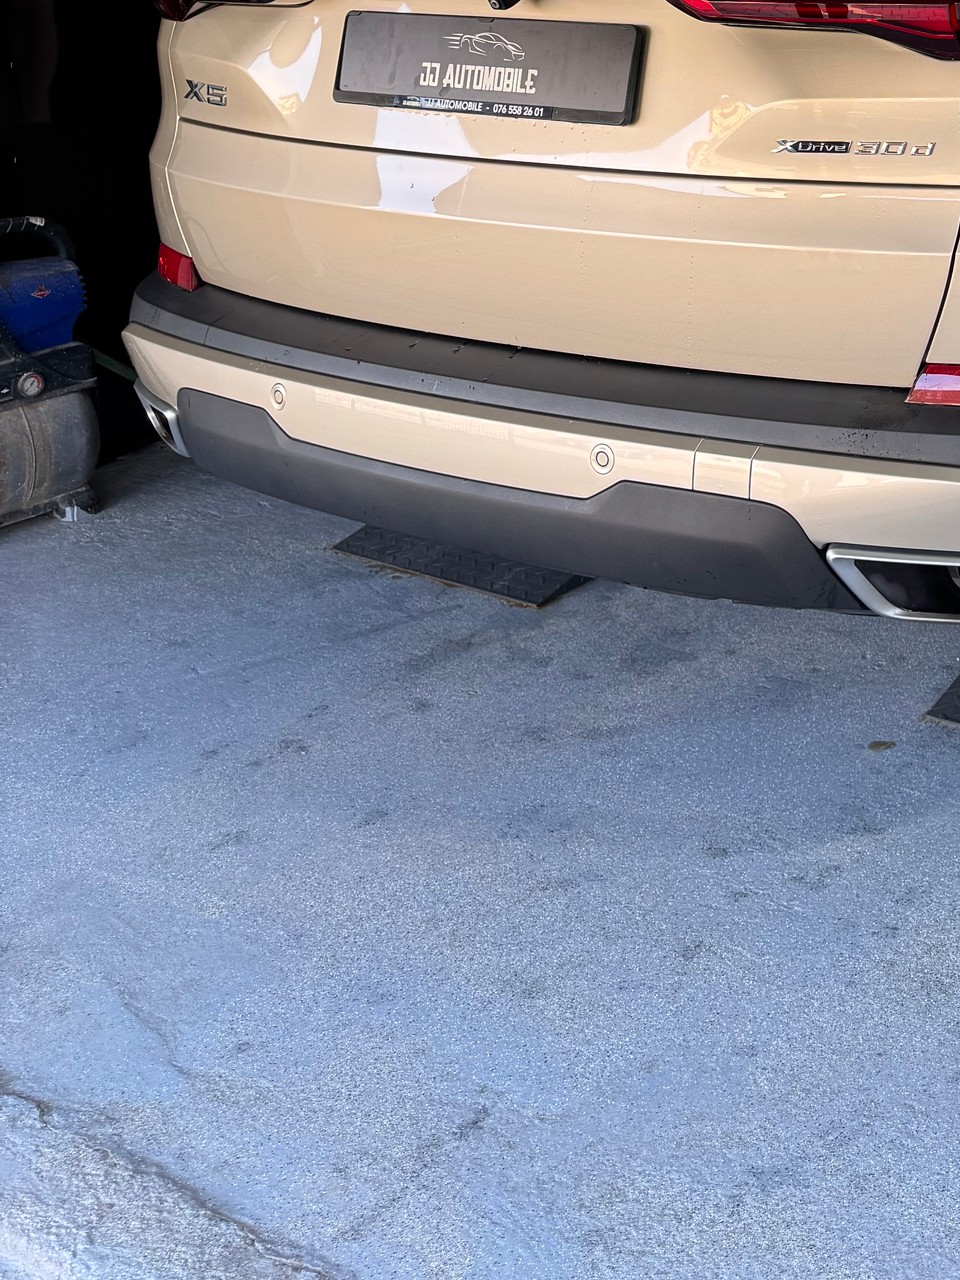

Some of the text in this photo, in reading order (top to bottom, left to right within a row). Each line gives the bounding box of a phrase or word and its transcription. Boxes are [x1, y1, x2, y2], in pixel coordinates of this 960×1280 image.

[184, 79, 228, 107] X5
[442, 64, 538, 94] AUTOMOBILE
[435, 99, 483, 112] AUTOMOBILE
[492, 103, 507, 114] 076
[508, 105, 522, 115] 558
[523, 106, 533, 116] 26
[533, 107, 544, 117] 01
